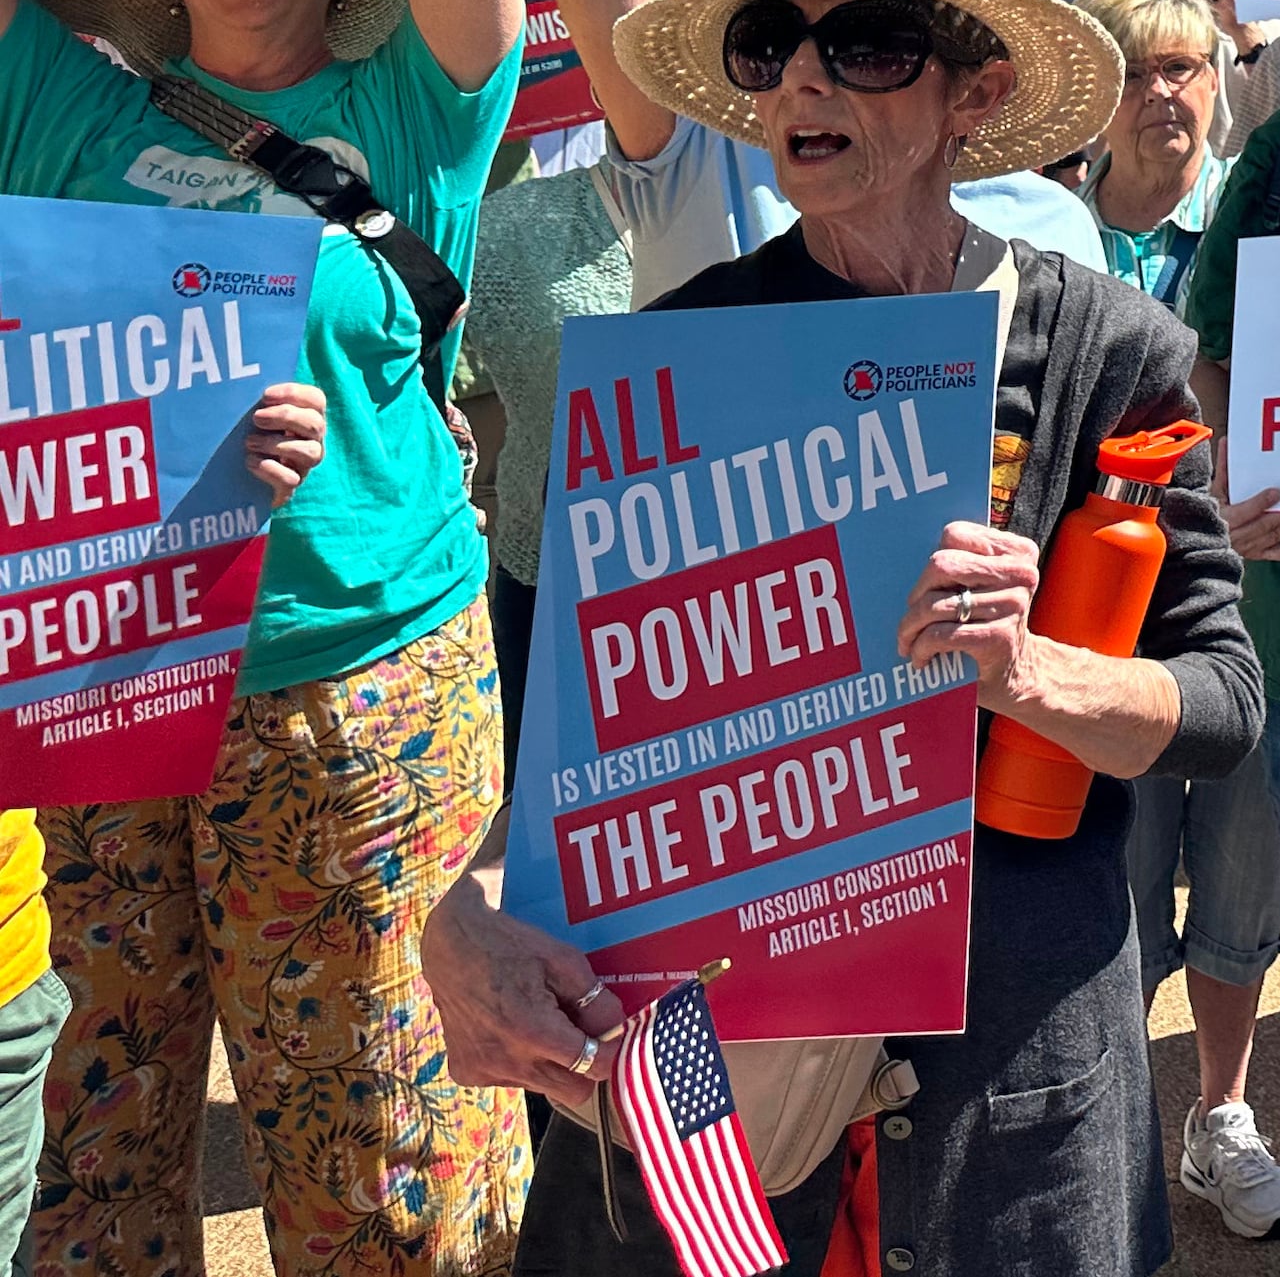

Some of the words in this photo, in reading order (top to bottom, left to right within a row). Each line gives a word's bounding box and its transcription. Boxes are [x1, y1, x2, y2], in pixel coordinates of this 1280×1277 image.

[213, 284, 295, 297] POLITICIANS
[215, 271, 265, 286] PEOPLE
[267, 275, 297, 286] NOT
[0, 300, 260, 423] LITICAL
[886, 364, 941, 380] PEOPLE
[943, 361, 976, 375] NOT
[886, 375, 976, 393] POLITICIANS
[566, 366, 700, 491] ALL
[0, 426, 151, 526] WER
[568, 399, 948, 599] POLITICAL
[20, 550, 72, 585] AND
[80, 523, 181, 571] DERIVED
[191, 506, 258, 544] FROM
[0, 564, 202, 673] PEOPLE
[591, 558, 848, 719] POWER
[16, 690, 106, 728] MISSOURI
[111, 654, 236, 702] CONSTITUTION,
[42, 712, 113, 747] ARTICLE
[133, 690, 203, 723] SECTION
[551, 767, 580, 808] IS
[585, 738, 682, 796] VESTED
[687, 726, 717, 765] IN
[725, 712, 775, 755] AND
[782, 673, 887, 735] DERIVED
[893, 652, 965, 700] FROM
[568, 798, 690, 907] THE
[699, 722, 919, 867] PEOPLE
[737, 881, 830, 933] MISSOURI
[833, 839, 966, 906] CONSTITUTION,
[768, 914, 841, 959] ARTICLE
[861, 883, 931, 930] SECTION
